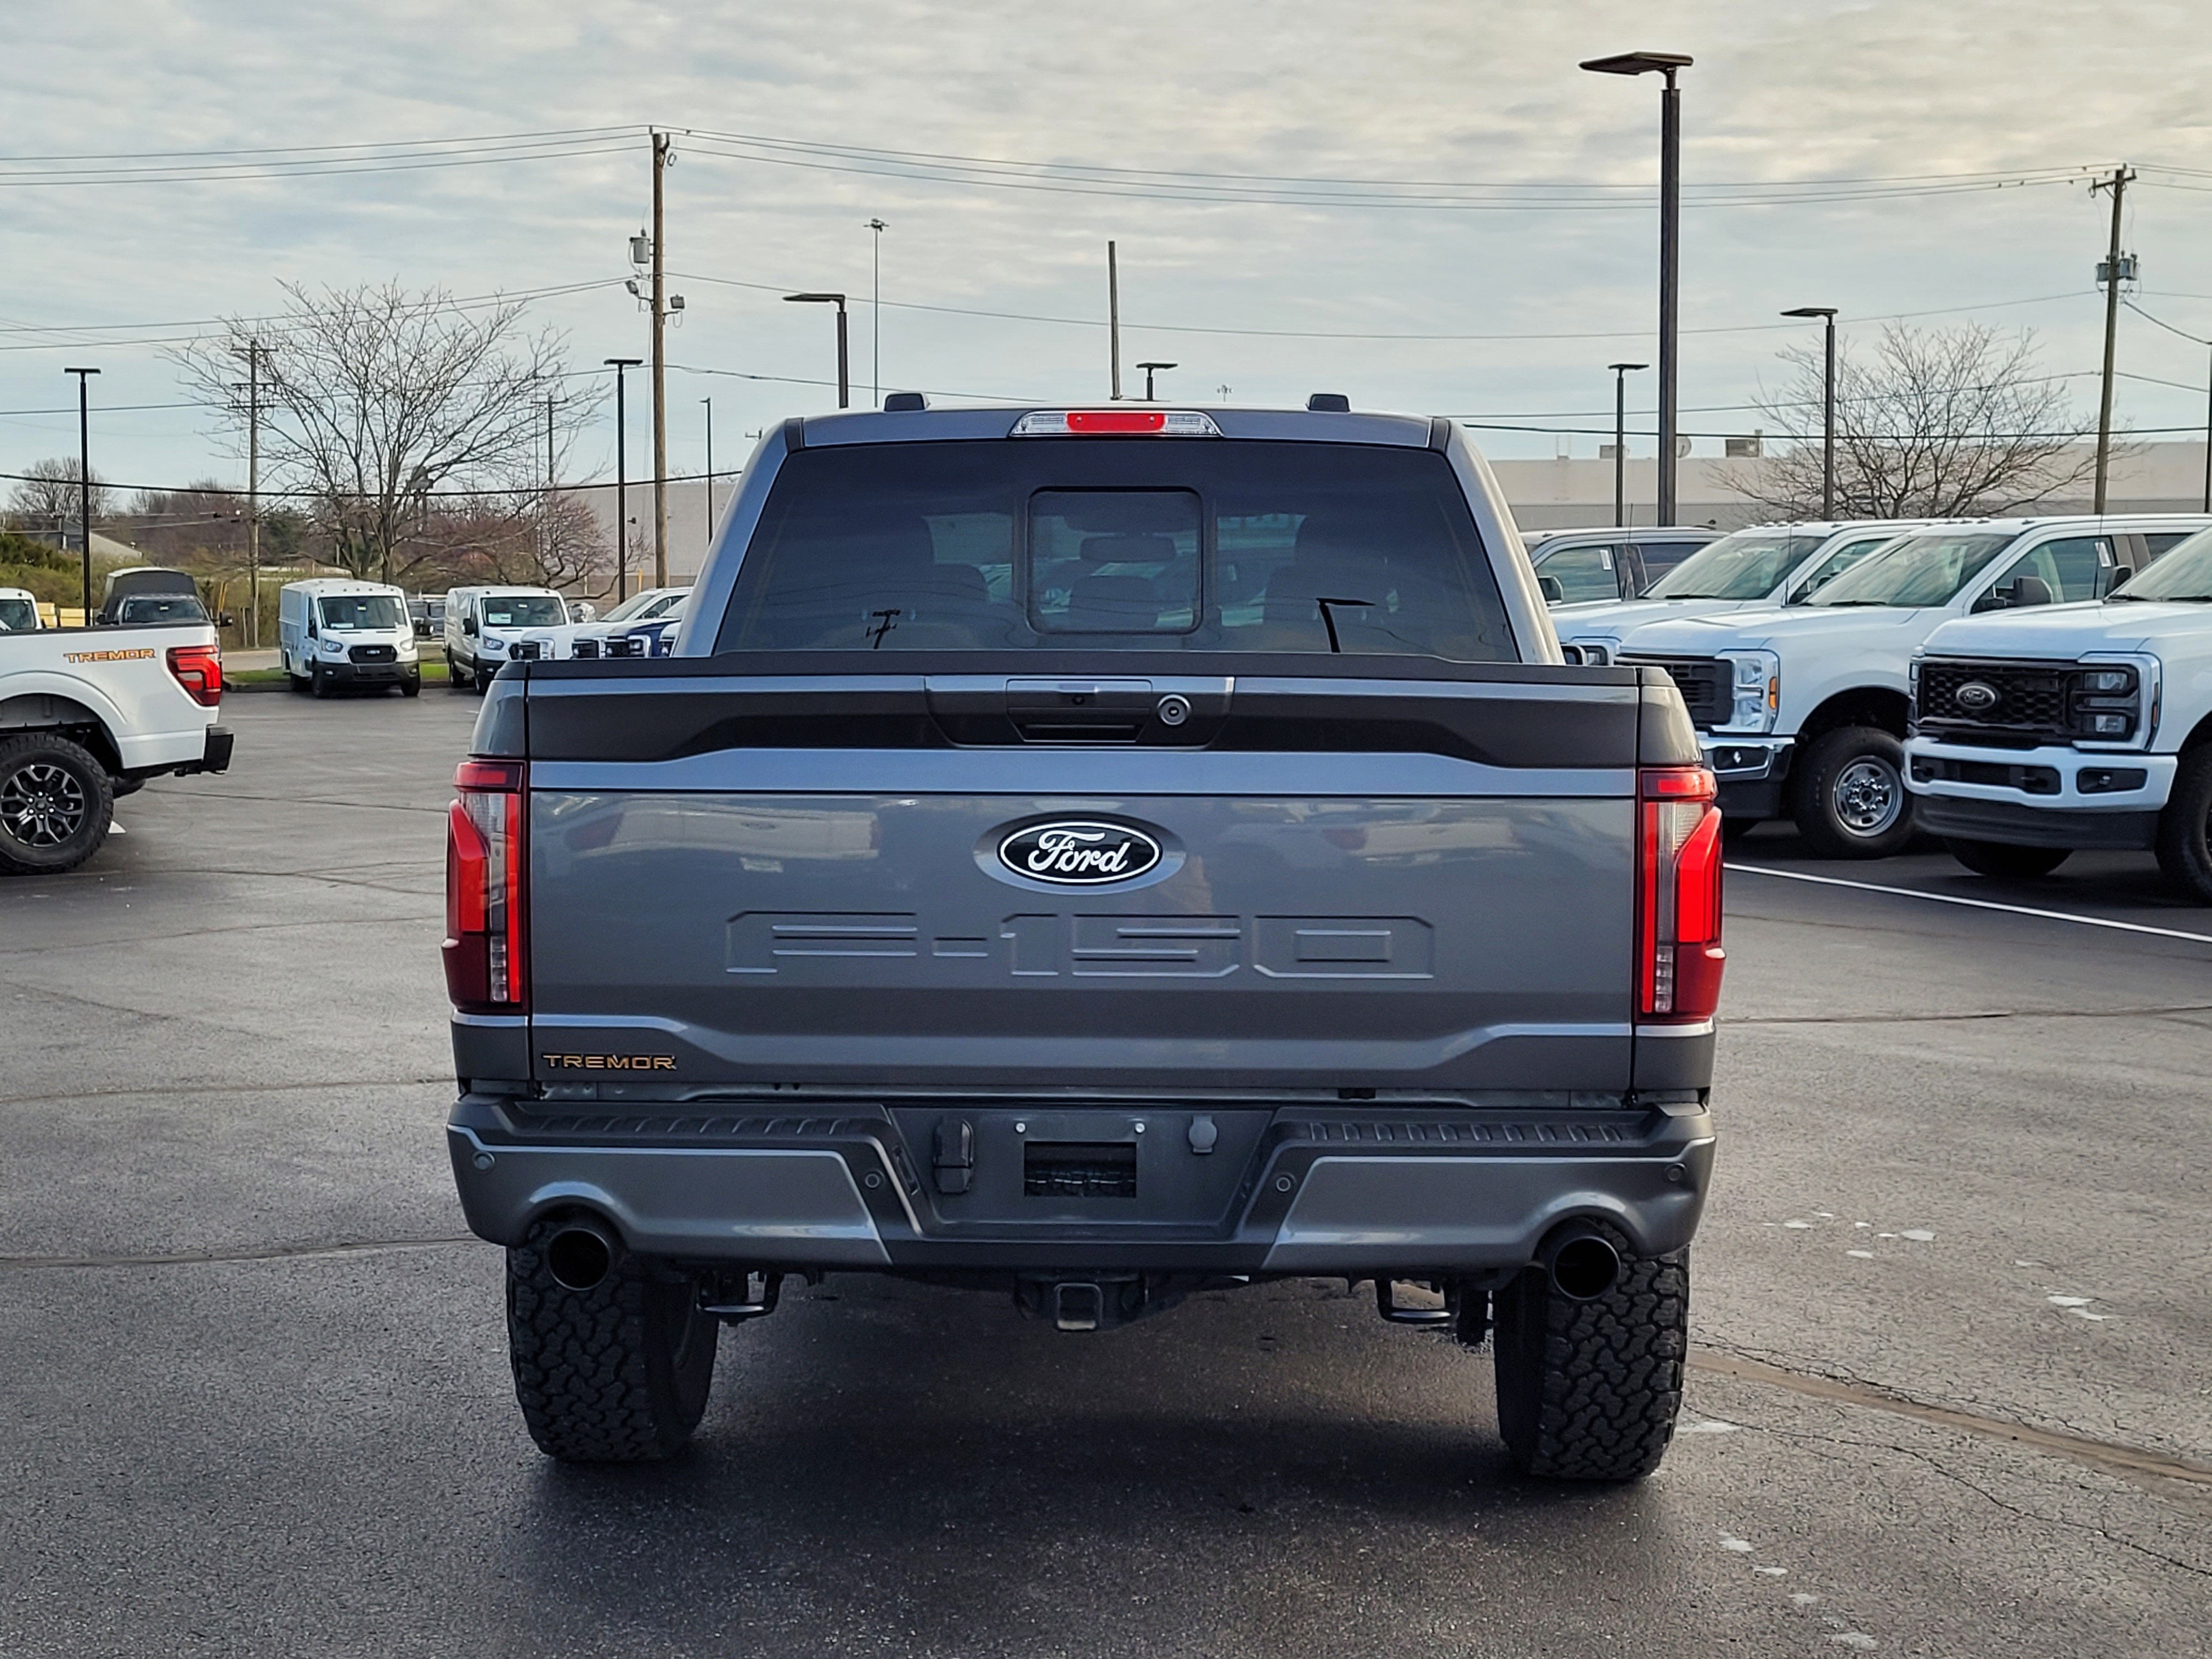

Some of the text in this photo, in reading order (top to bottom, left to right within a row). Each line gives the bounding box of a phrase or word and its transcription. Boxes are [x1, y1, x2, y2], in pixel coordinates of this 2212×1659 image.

[63, 648, 155, 663] TREMOR
[1028, 830, 1131, 872] Ford
[725, 911, 1434, 979] F-150
[543, 1054, 677, 1069] TREMOR
